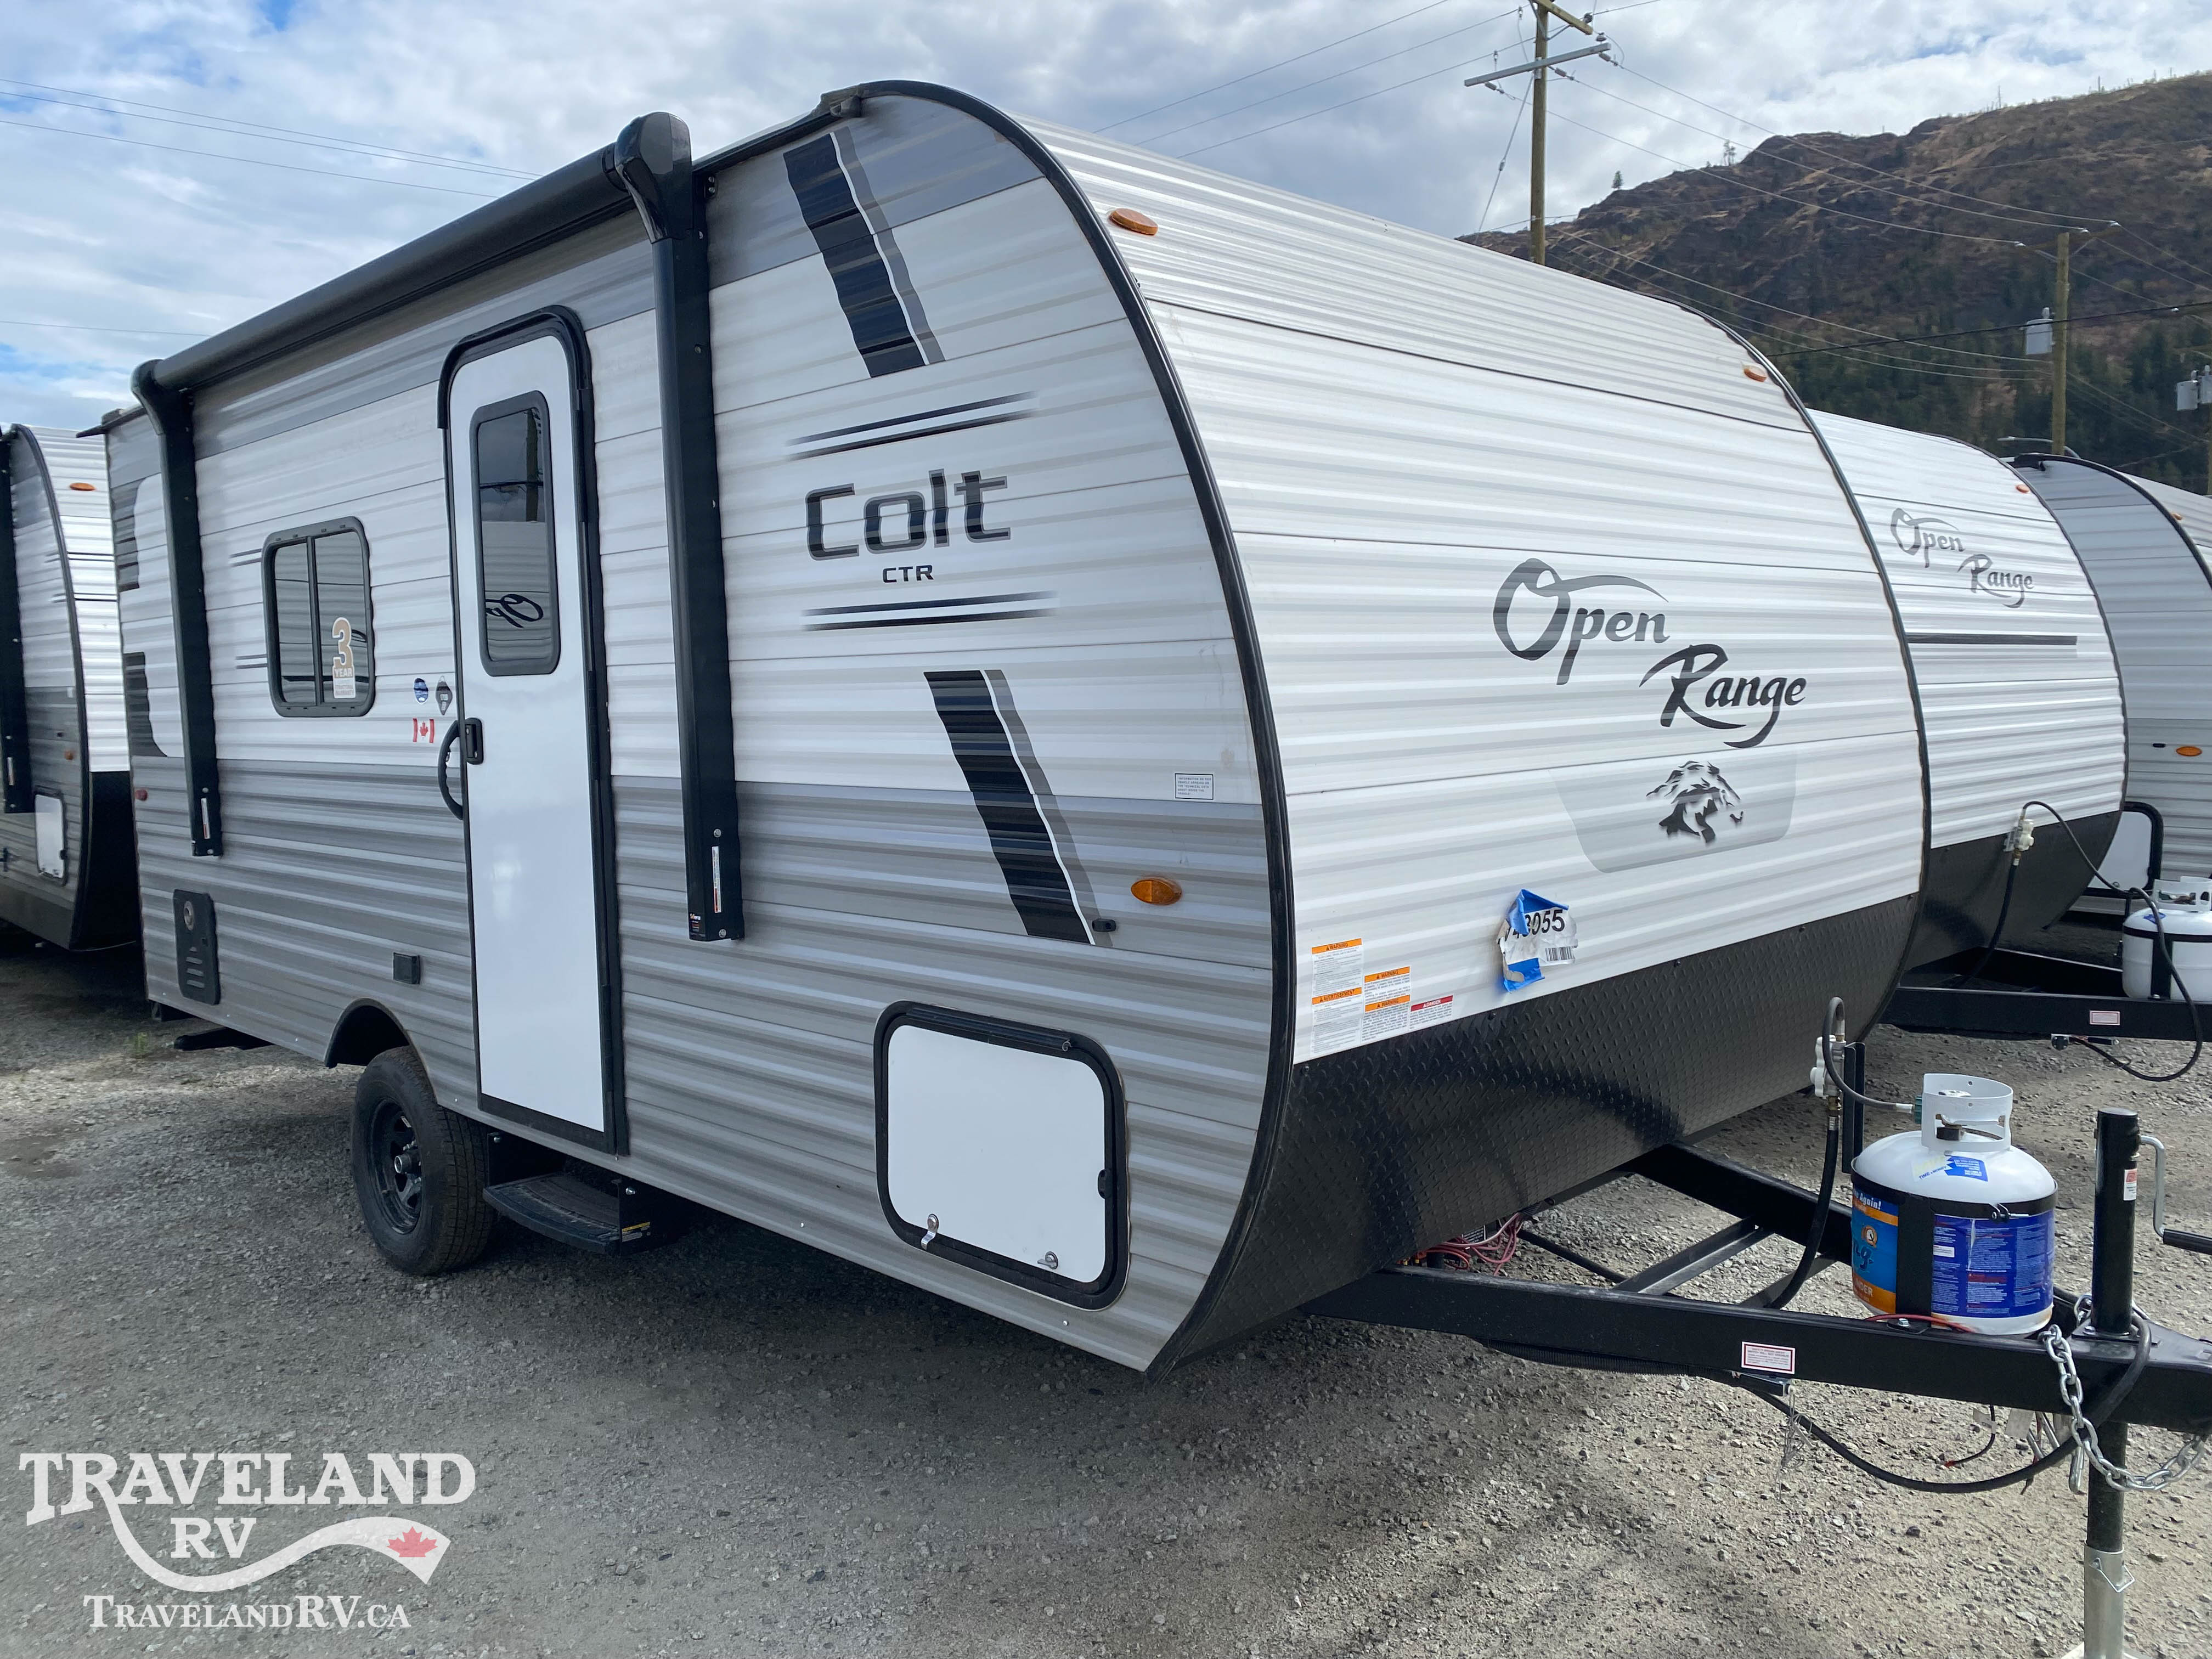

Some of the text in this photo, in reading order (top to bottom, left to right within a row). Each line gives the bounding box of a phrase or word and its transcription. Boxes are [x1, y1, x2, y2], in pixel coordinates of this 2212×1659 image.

[805, 468, 1011, 561] Colt
[1891, 507, 1966, 568] Open
[882, 564, 934, 583] CTR
[1957, 554, 2035, 608] Range
[1493, 557, 1671, 685] Open
[333, 618, 353, 668] 3
[335, 668, 353, 677] YEAR
[1639, 643, 1807, 748] Range
[1329, 942, 1348, 950] WARNING
[1381, 969, 1398, 978] WARNING
[1426, 999, 1441, 1007] DANGER
[1859, 1192, 1882, 1210] Again!
